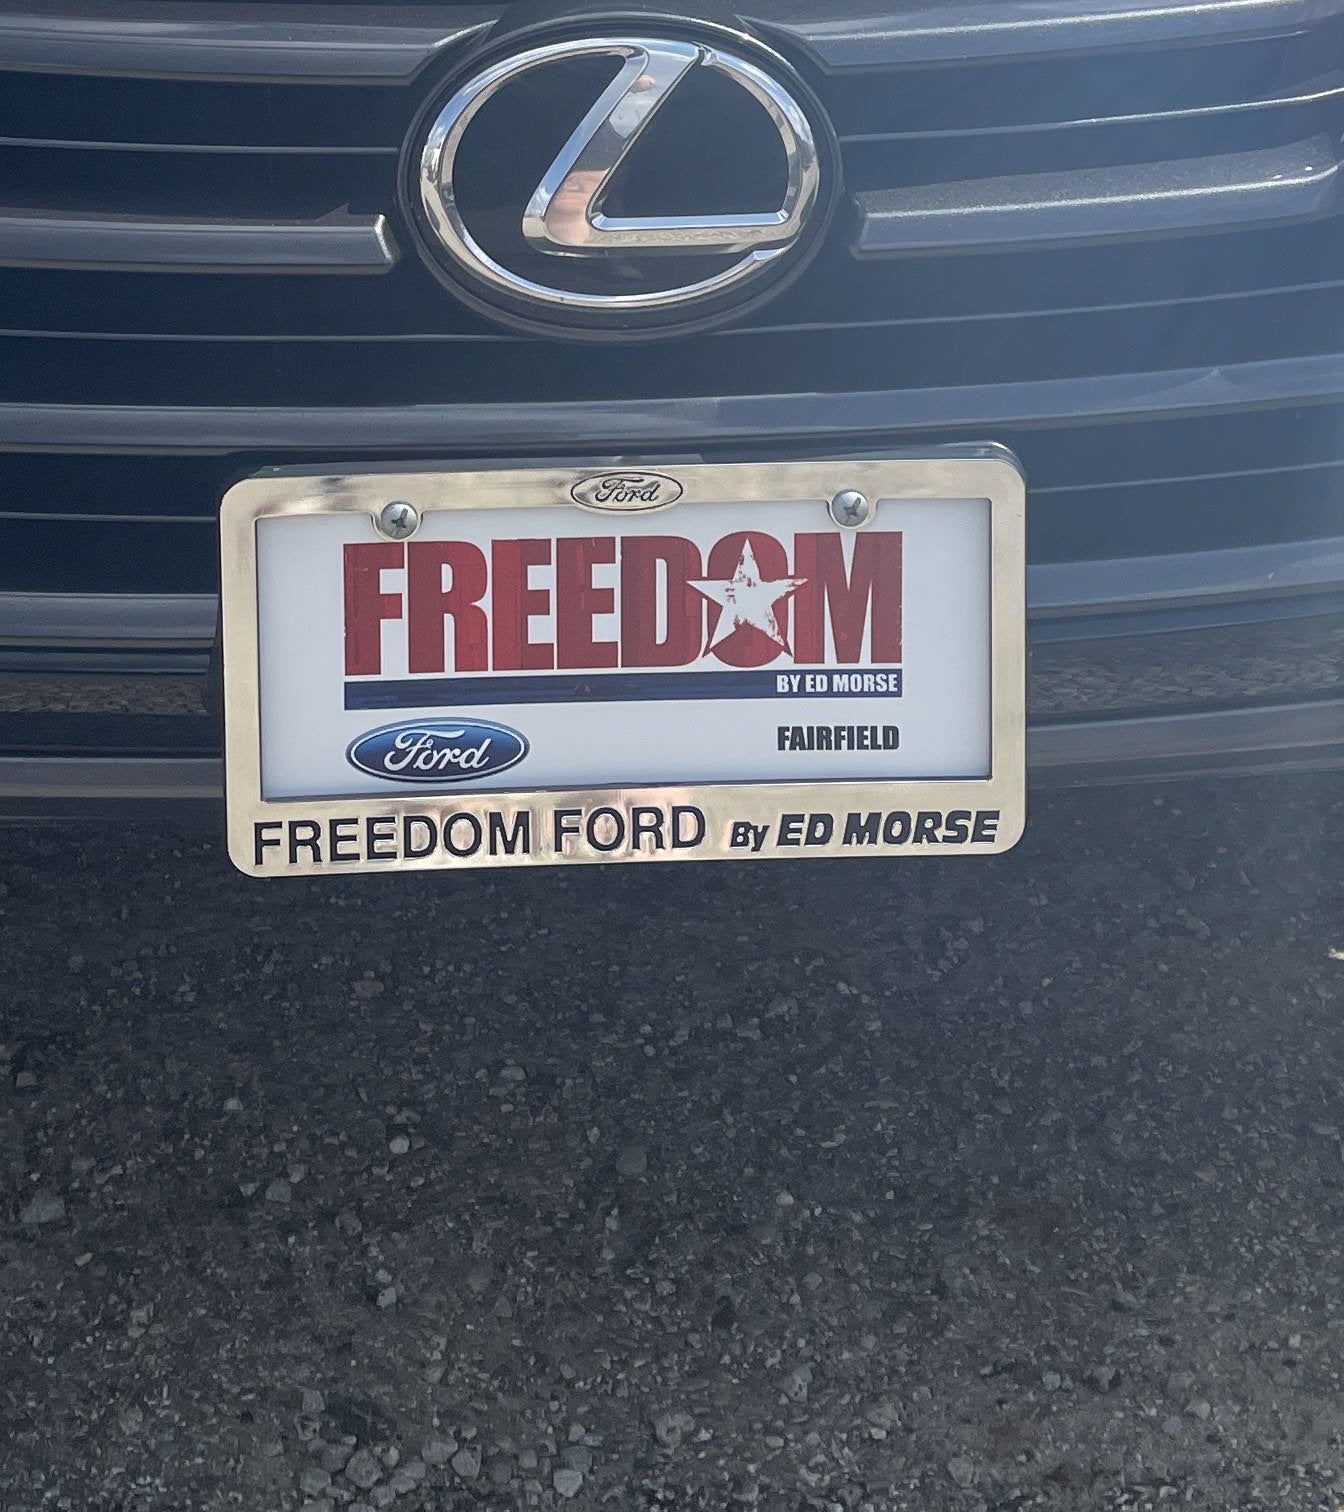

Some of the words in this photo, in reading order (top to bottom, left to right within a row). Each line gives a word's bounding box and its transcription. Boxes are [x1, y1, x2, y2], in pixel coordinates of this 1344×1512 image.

[595, 476, 661, 502] Ford
[343, 530, 903, 675] FREEDOM
[776, 674, 801, 693] BY
[805, 674, 828, 693] ED
[832, 673, 898, 692] MORSE
[383, 729, 492, 771] Ford
[777, 725, 900, 751] FAIRFIELD
[253, 810, 530, 865] FREEDOM
[553, 805, 706, 853] FORD
[729, 821, 770, 852] By
[776, 813, 832, 847] ED
[842, 810, 1001, 845] MORSE
